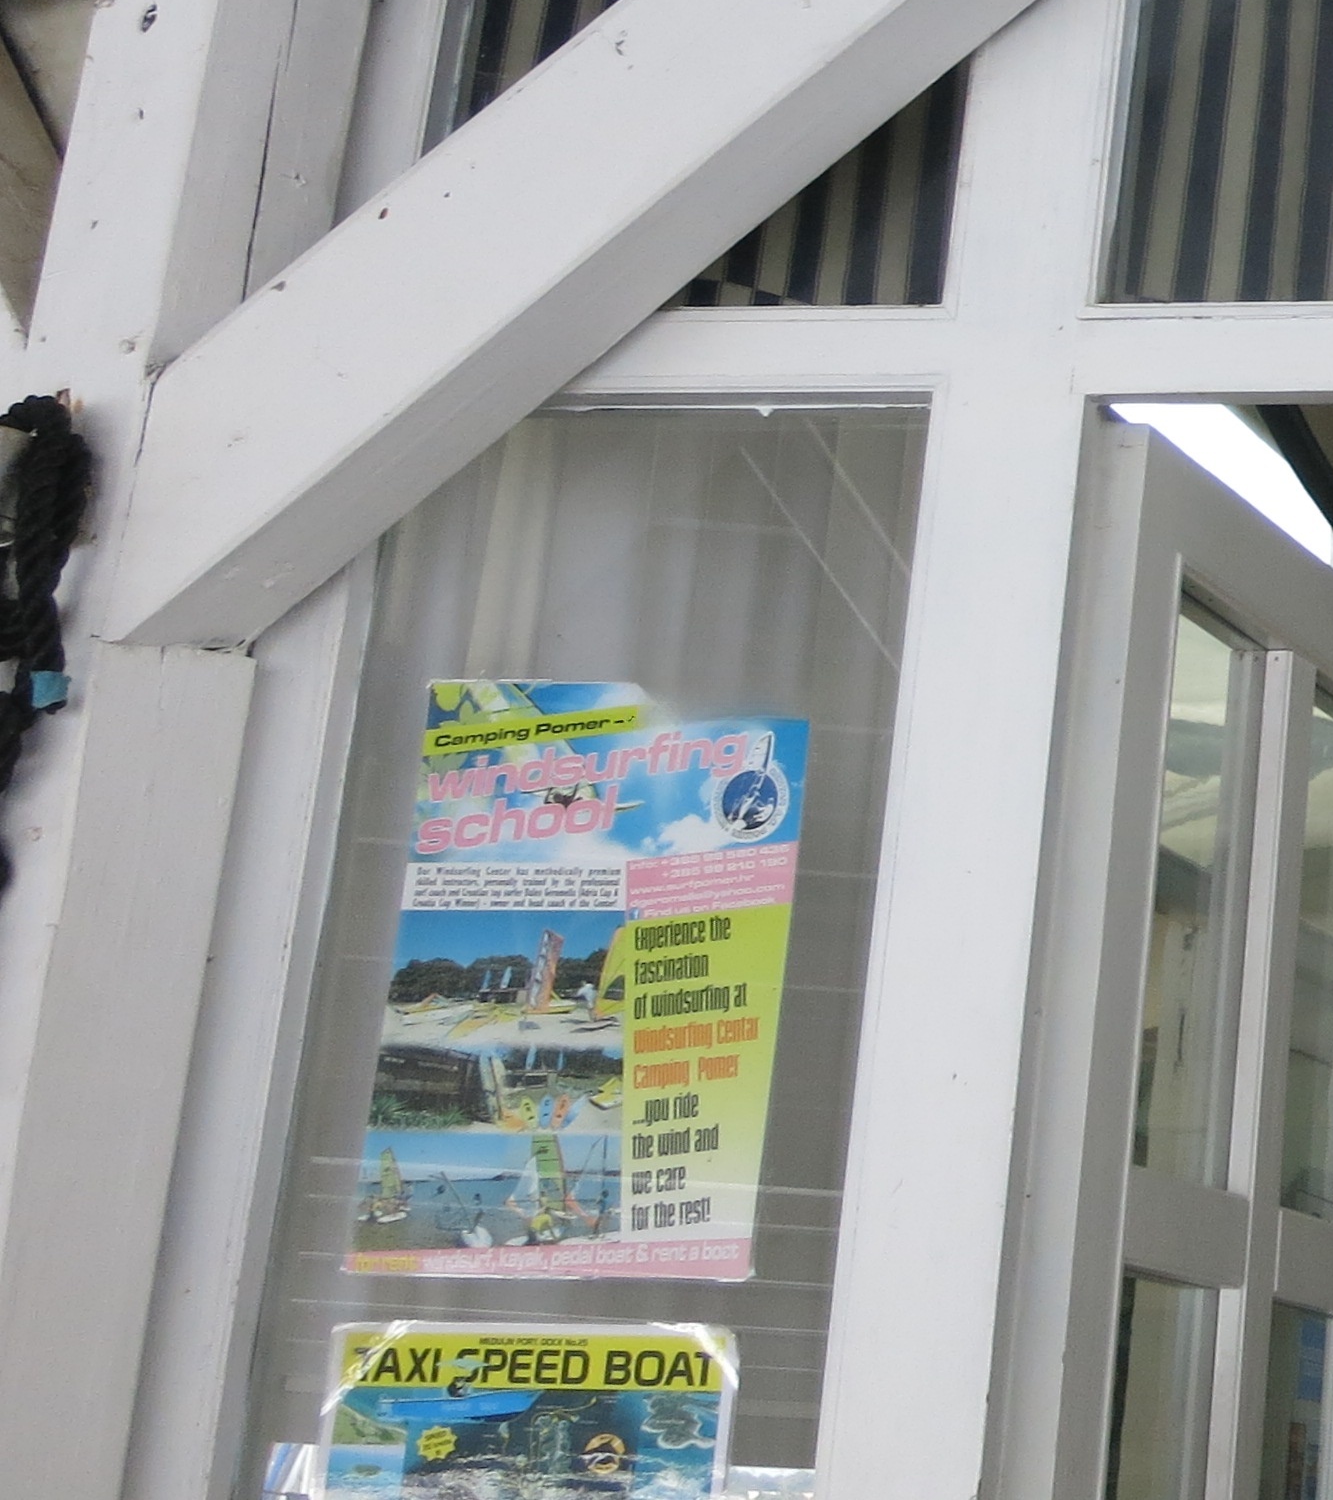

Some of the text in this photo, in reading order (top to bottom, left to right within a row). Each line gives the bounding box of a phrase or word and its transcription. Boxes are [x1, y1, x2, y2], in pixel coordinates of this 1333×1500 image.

[434, 716, 609, 748] Camping Pomer
[428, 729, 750, 803] windsurfing
[416, 784, 617, 856] school
[634, 915, 731, 952] Experience the
[634, 953, 709, 986] fascination
[634, 982, 749, 1019] of windsurfing at
[634, 1020, 714, 1055] Windsurfing
[633, 1054, 741, 1089] Camping Pomer
[672, 1092, 699, 1120] ride
[632, 1123, 720, 1160] the wind and
[631, 1166, 686, 1195] we care
[631, 1197, 712, 1232] for the rest!
[353, 1346, 715, 1387] TAXI SPEED BOAT
